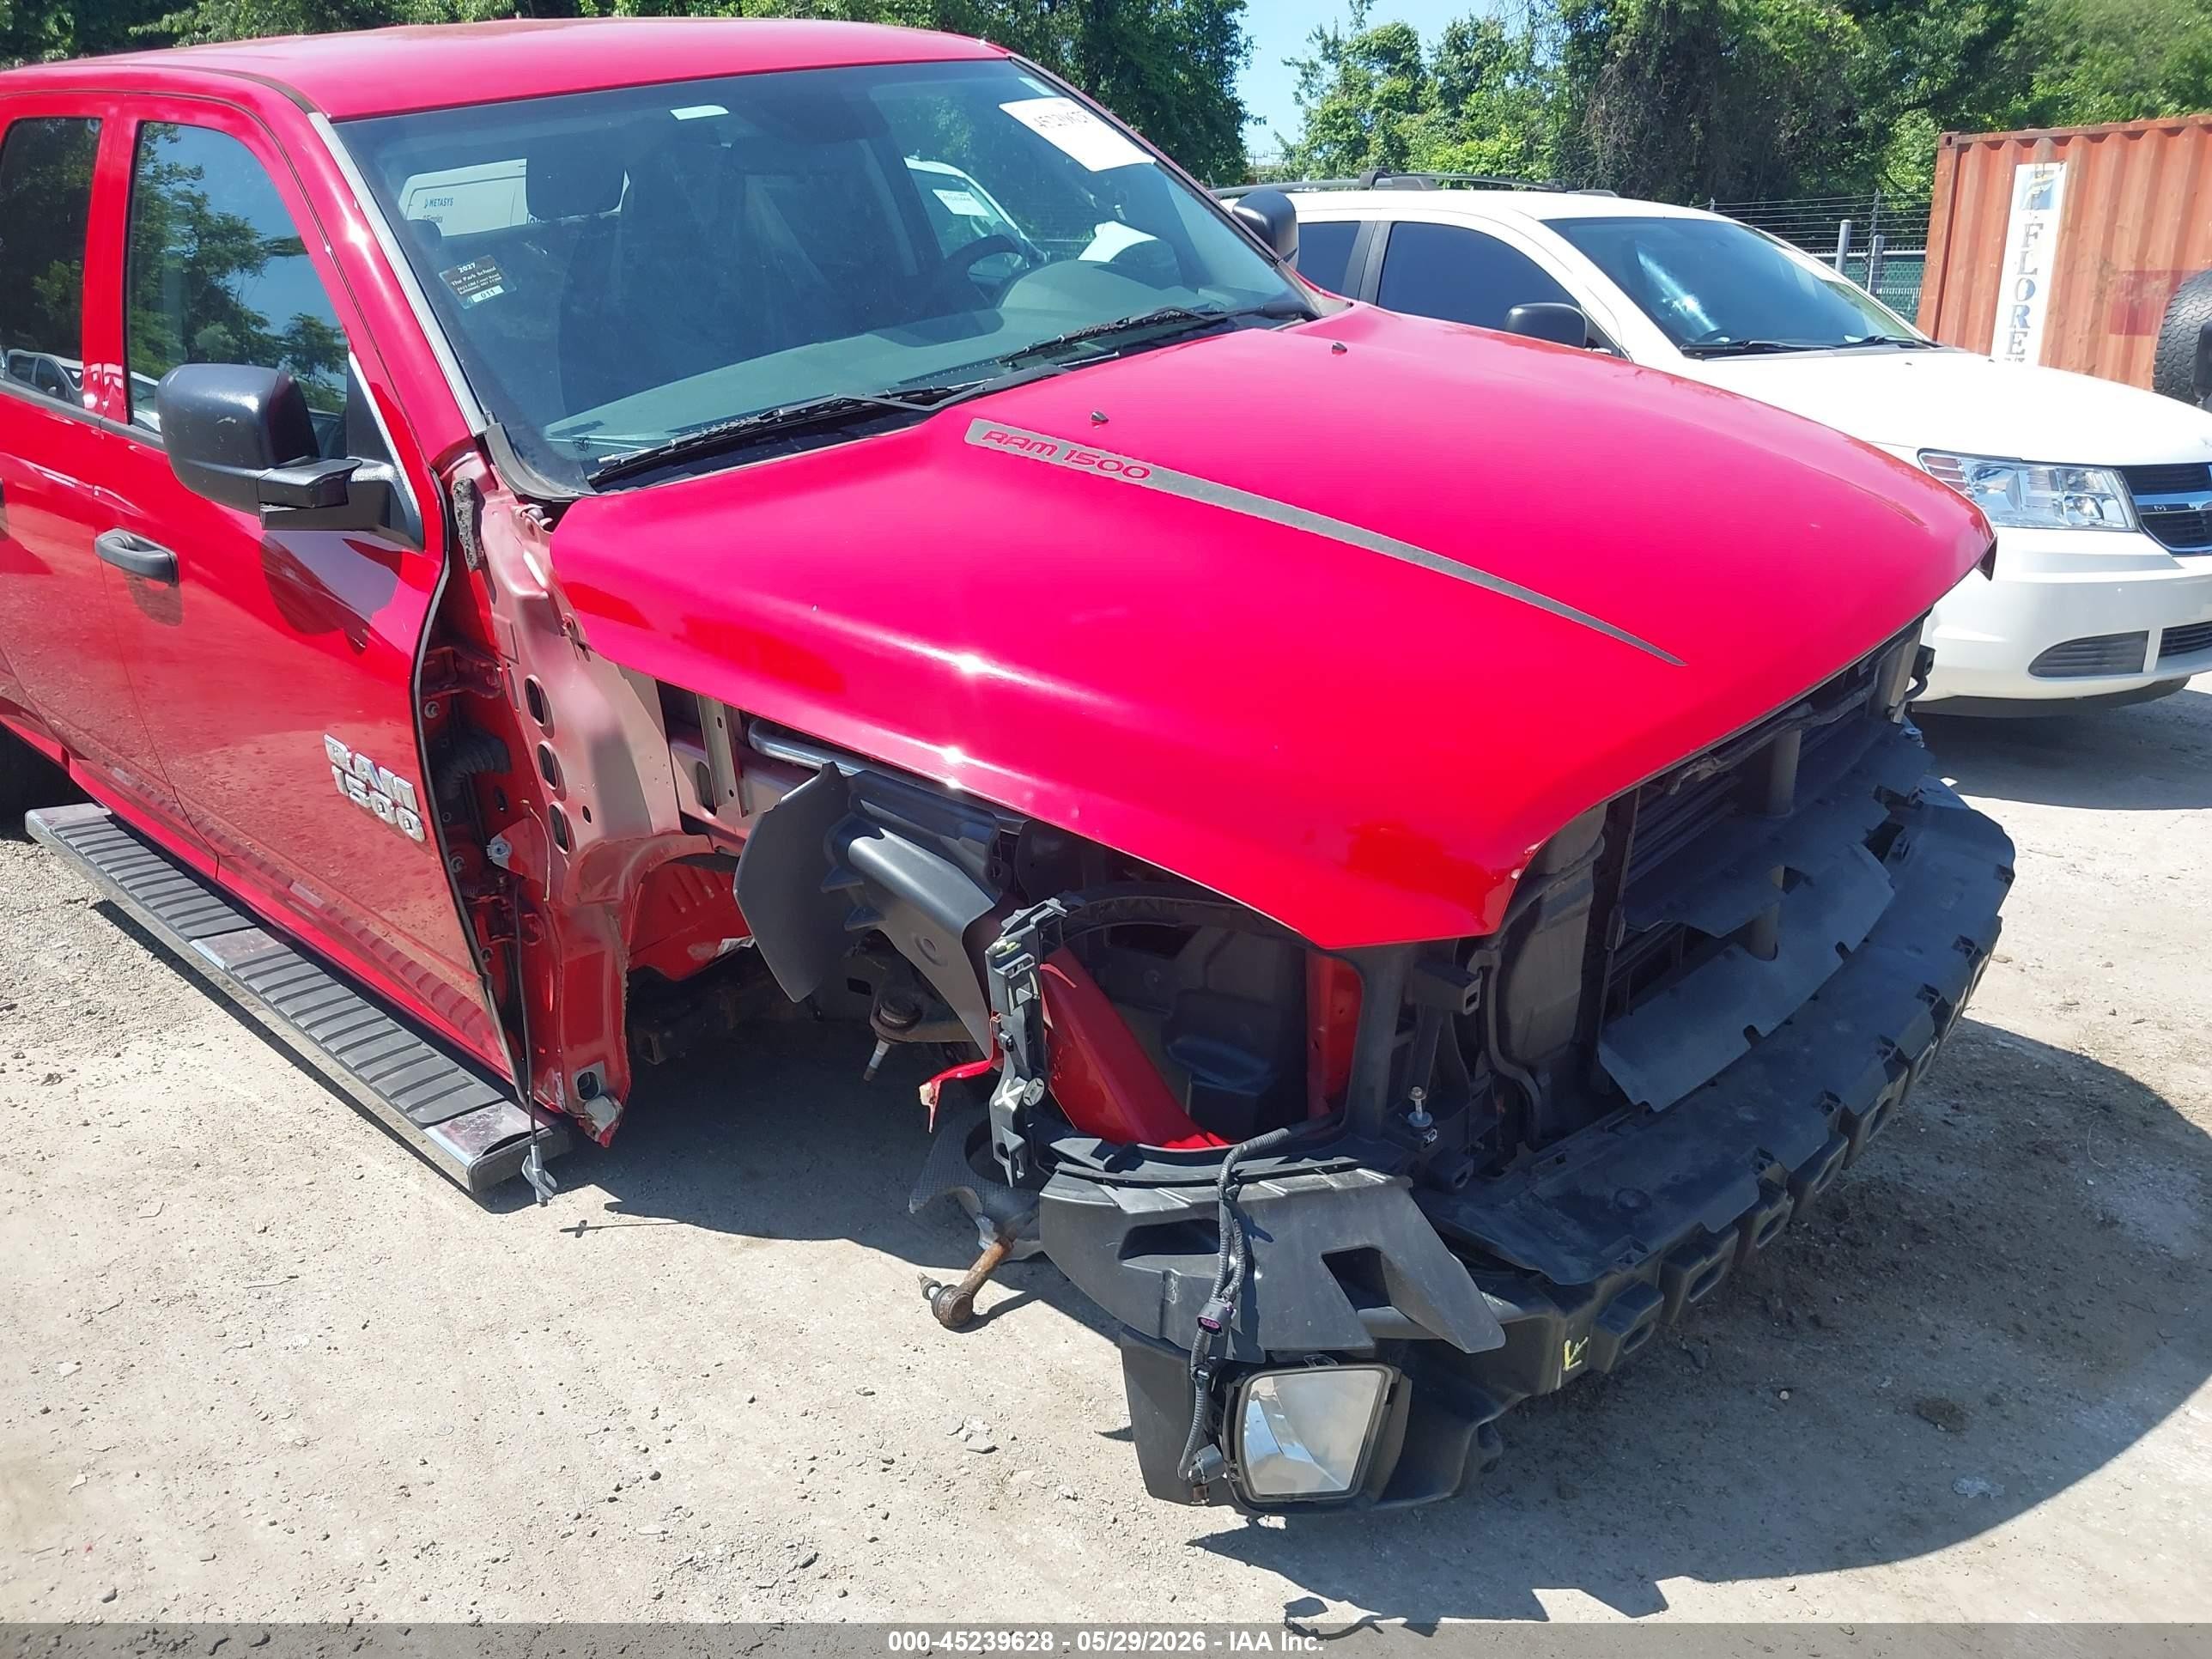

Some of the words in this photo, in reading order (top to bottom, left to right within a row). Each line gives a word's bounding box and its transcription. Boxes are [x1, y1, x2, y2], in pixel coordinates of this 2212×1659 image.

[428, 198, 454, 207] METASYS
[458, 262, 477, 273] 2027
[2004, 222, 2044, 362] FLORE
[480, 289, 495, 299] 011
[982, 429, 1058, 457] RAM
[1063, 449, 1151, 479] 1500
[324, 733, 419, 812] RAM
[331, 764, 426, 842] 1500
